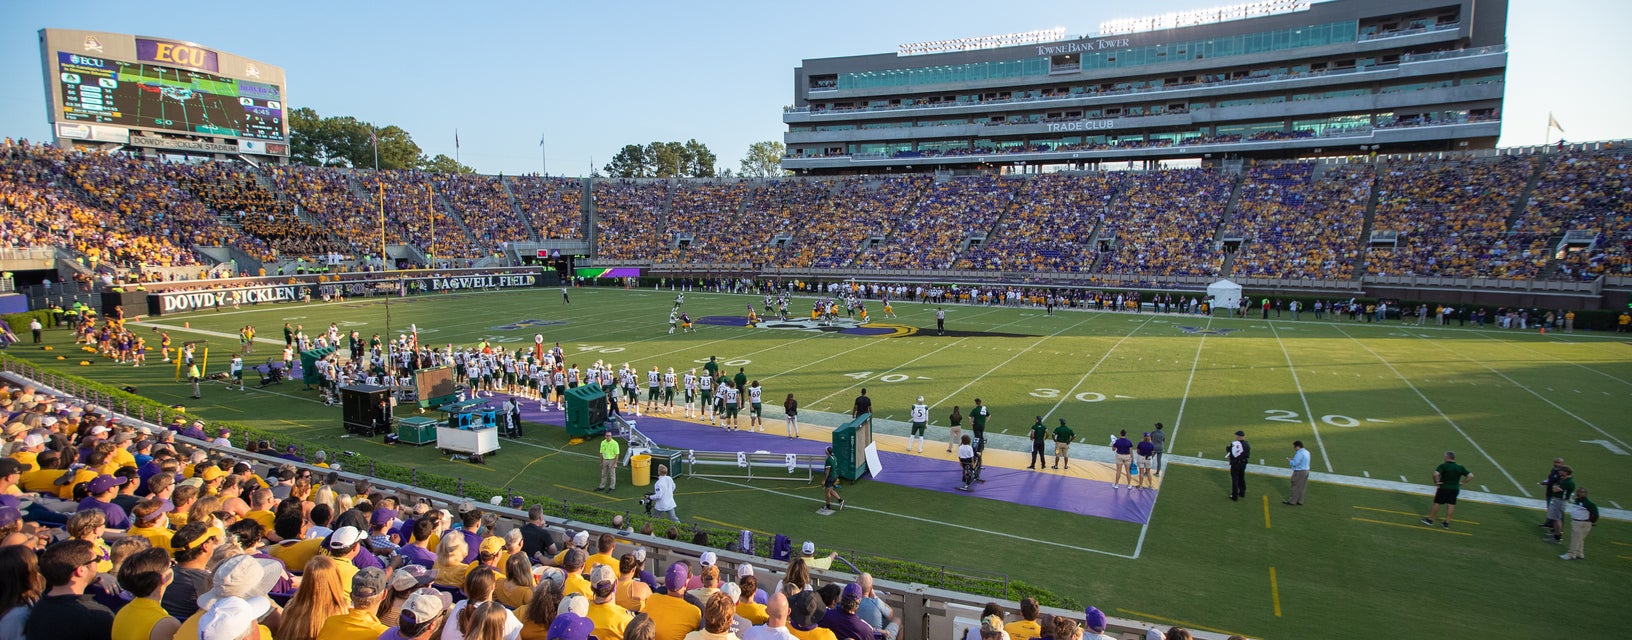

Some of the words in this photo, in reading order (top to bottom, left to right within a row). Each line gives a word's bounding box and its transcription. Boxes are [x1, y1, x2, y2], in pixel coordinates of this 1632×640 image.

[1096, 38, 1129, 50] TOWER
[154, 42, 207, 67] ECU
[80, 56, 104, 68] ECU
[1047, 121, 1082, 132] TRADE
[1085, 120, 1114, 130] CLUB
[499, 275, 536, 287] FIELD
[666, 375, 674, 384] 40
[701, 377, 710, 387] 43
[843, 371, 911, 385] 40
[727, 392, 737, 400] 57
[752, 389, 761, 398] 69
[1028, 387, 1107, 402] 30
[917, 409, 923, 418] 5
[1264, 409, 1361, 428] 20
